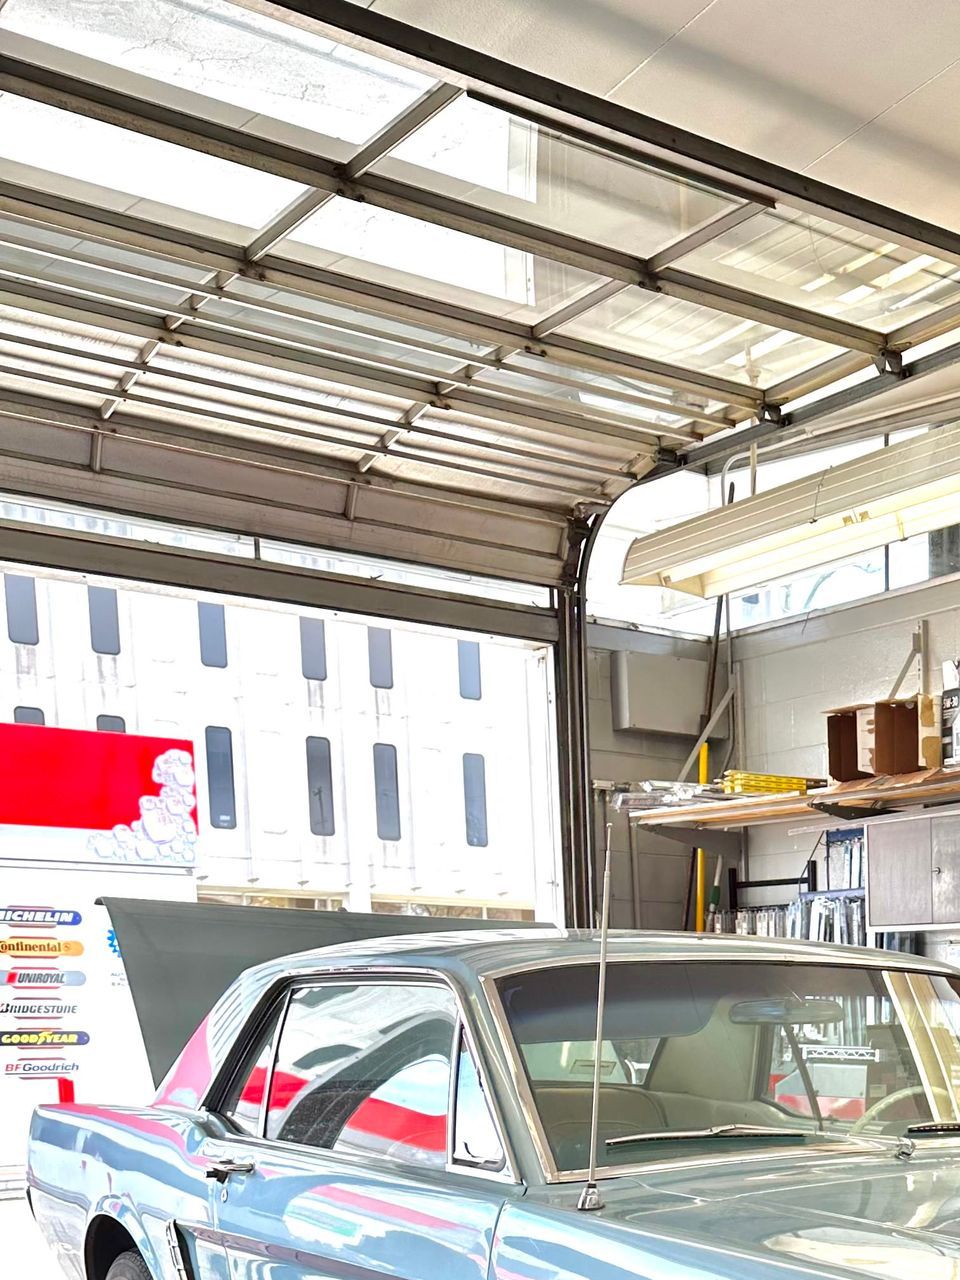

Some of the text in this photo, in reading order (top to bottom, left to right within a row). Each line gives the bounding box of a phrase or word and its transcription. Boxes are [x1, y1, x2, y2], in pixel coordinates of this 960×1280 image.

[17, 972, 65, 984] UNIROYAL
[2, 1031, 79, 1045] GOODYEAR
[5, 1063, 79, 1073] BFGoodrich
